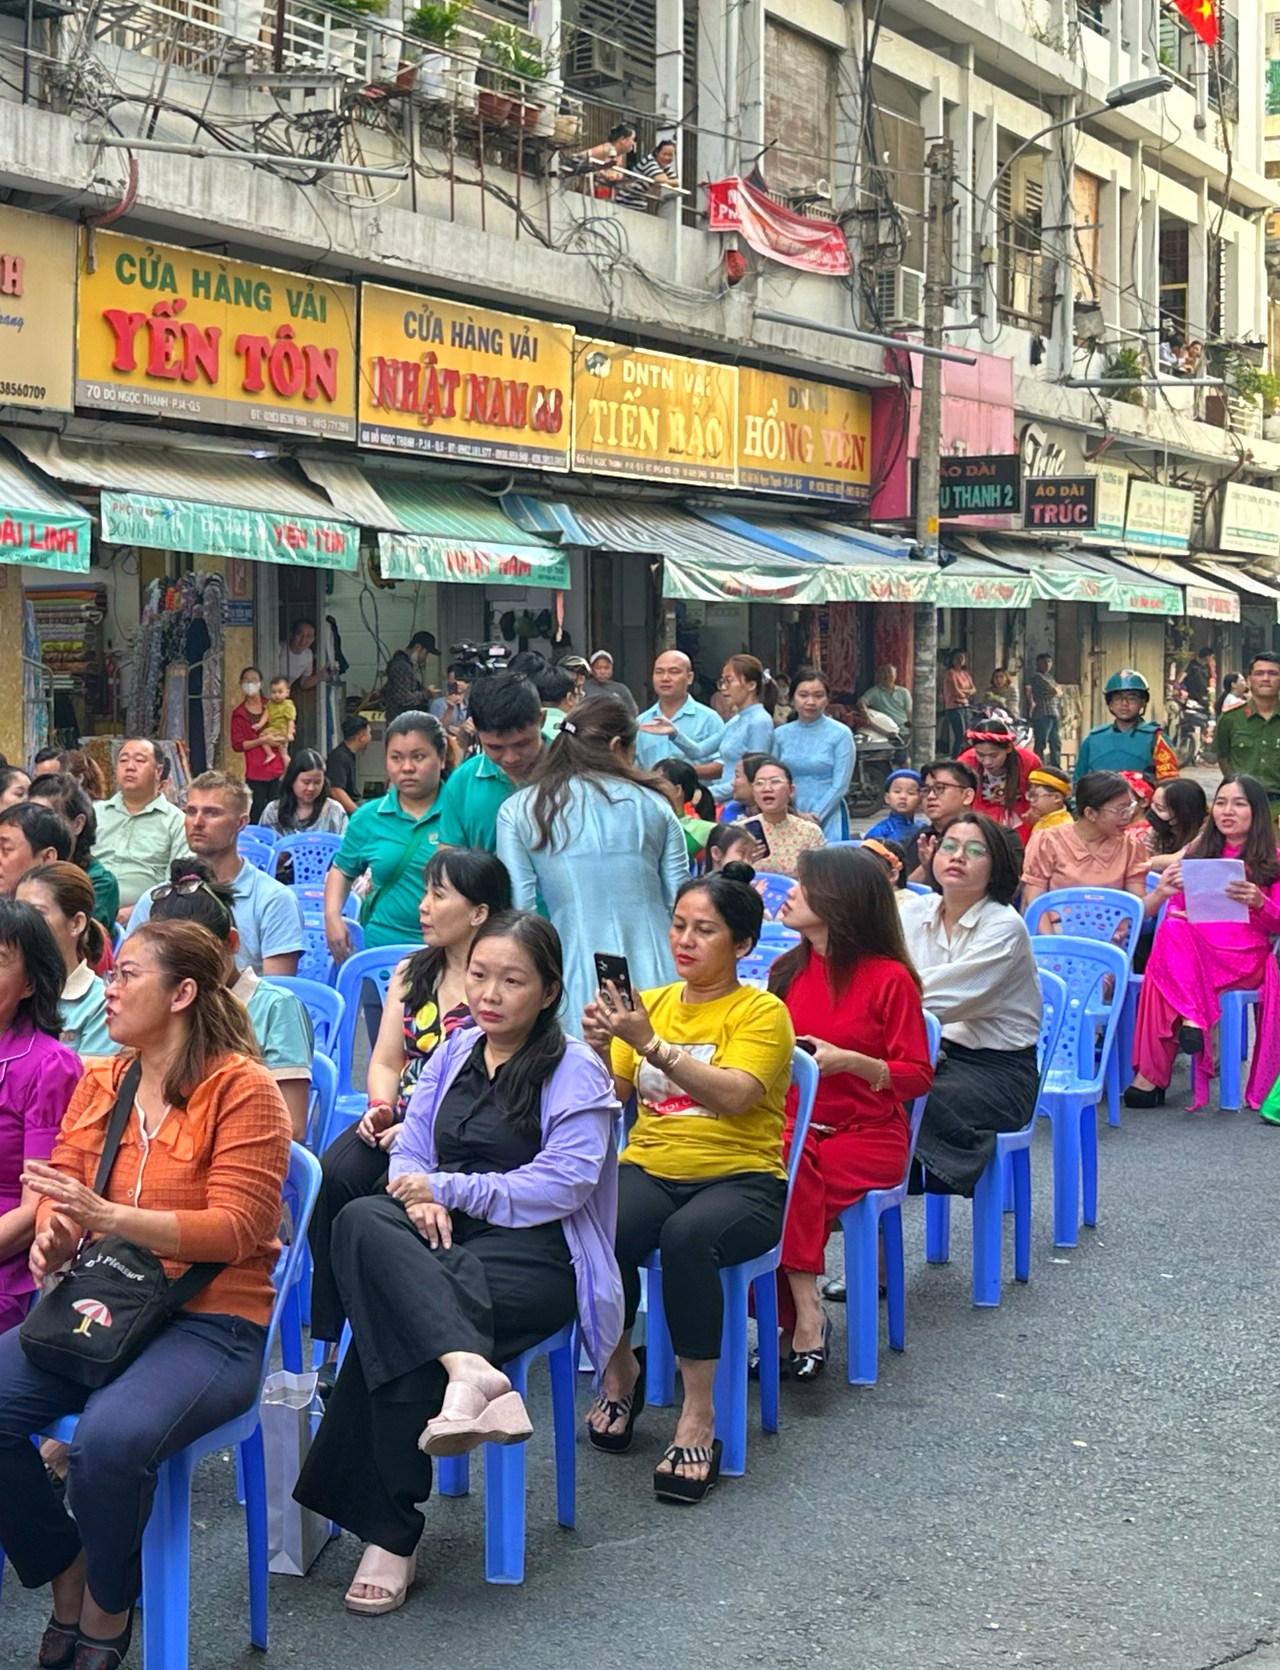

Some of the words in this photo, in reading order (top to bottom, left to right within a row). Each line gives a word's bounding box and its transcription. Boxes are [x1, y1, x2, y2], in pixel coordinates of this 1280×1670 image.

[115, 246, 178, 294] CỬA
[192, 264, 272, 313] HÀNG
[286, 282, 327, 323] VẢI
[403, 304, 444, 345] CỬA
[451, 316, 503, 356] HÀNG
[509, 325, 538, 362] VẢI
[102, 298, 221, 384] YẾN
[234, 324, 338, 402] TÔN
[0, 381, 46, 400] 38560709
[371, 351, 460, 426] NHẬT
[463, 373, 529, 430] NAM
[623, 360, 674, 390] DNTN
[86, 385, 100, 399] 70
[588, 388, 660, 451] TIẾN
[668, 397, 722, 459] BẢO
[743, 398, 813, 464] HỒNG
[820, 411, 866, 472] YẾN
[952, 484, 1002, 509] THANH
[1004, 485, 1013, 507] 2
[1031, 499, 1088, 524] TRÚC
[29, 523, 78, 555] LINH
[102, 1256, 145, 1281] Pleasure
